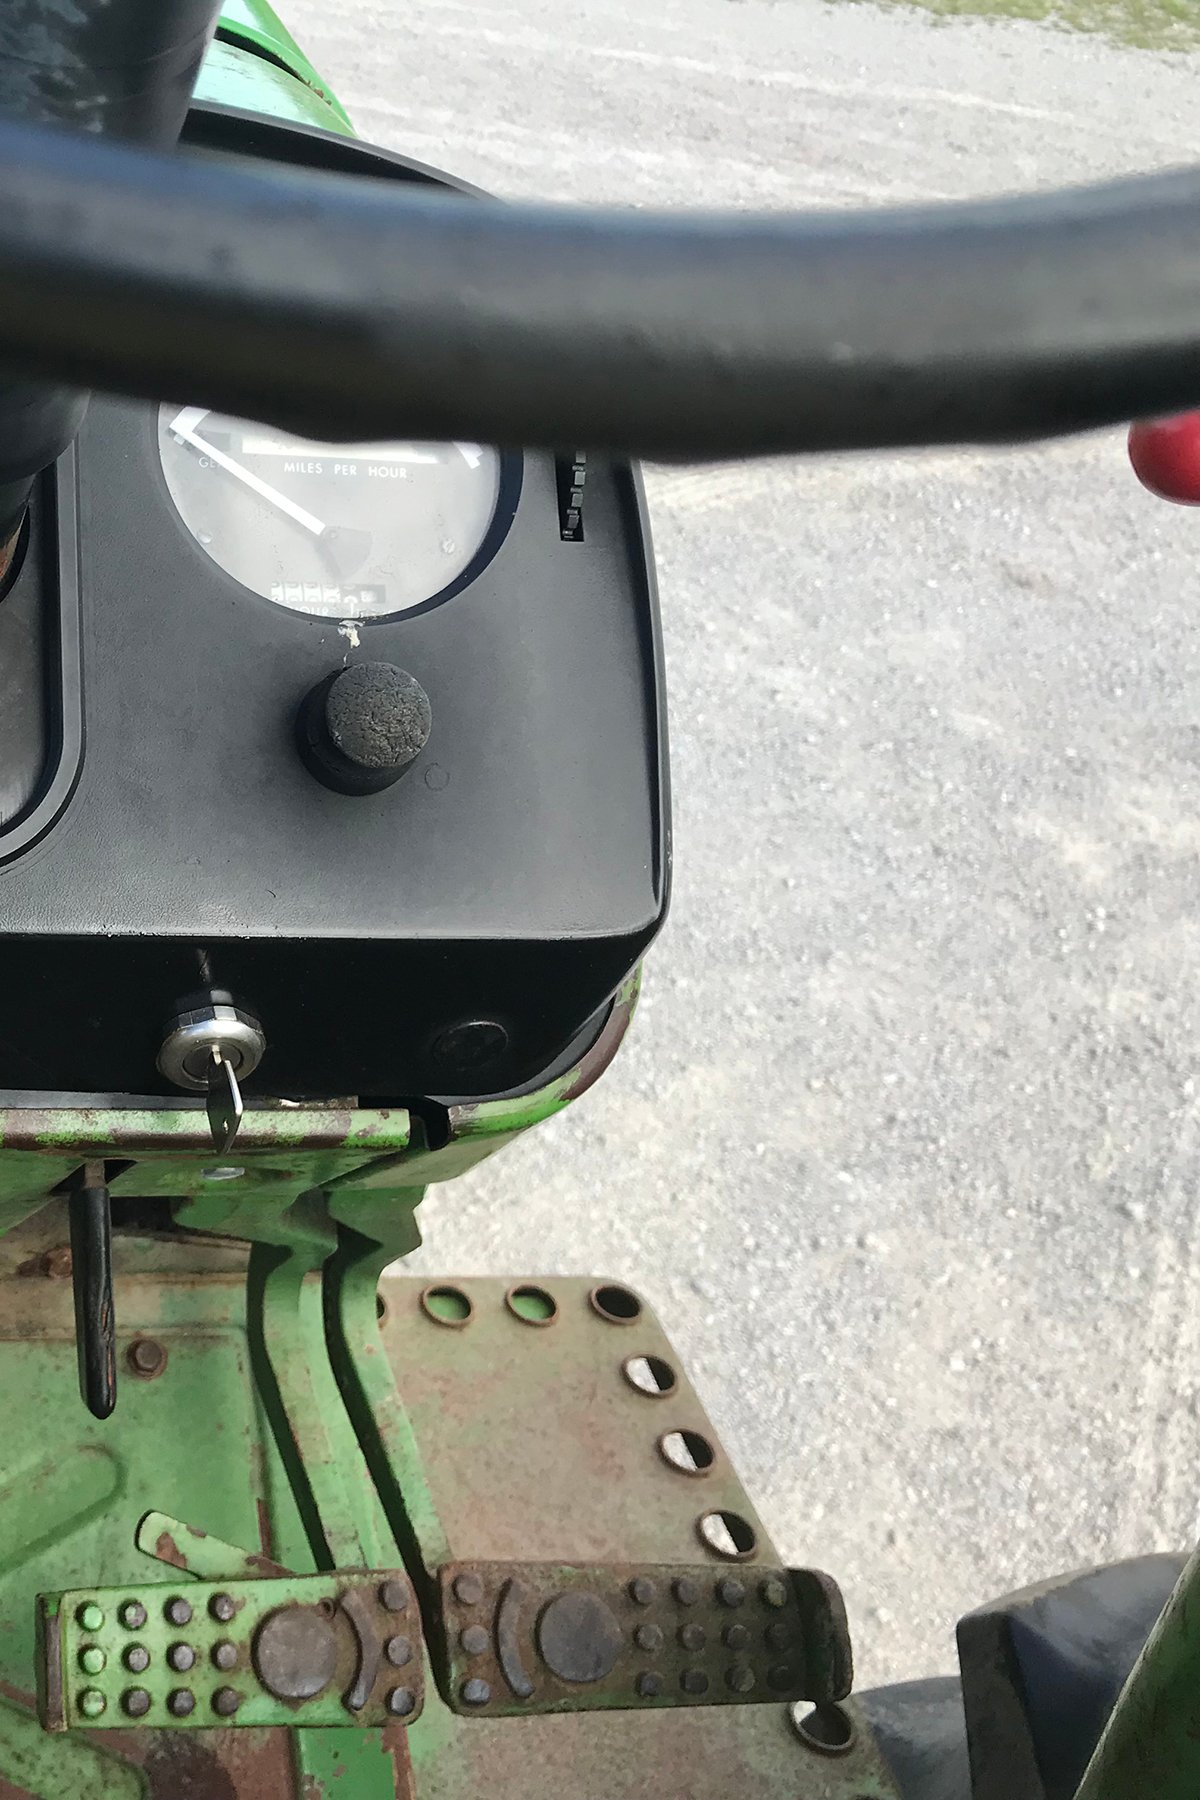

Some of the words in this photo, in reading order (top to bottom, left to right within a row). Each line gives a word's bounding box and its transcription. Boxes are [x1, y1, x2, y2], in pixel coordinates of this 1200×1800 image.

[198, 456, 222, 469] GE
[283, 462, 323, 474] MILES
[334, 464, 357, 476] PER
[368, 466, 408, 479] HOUR
